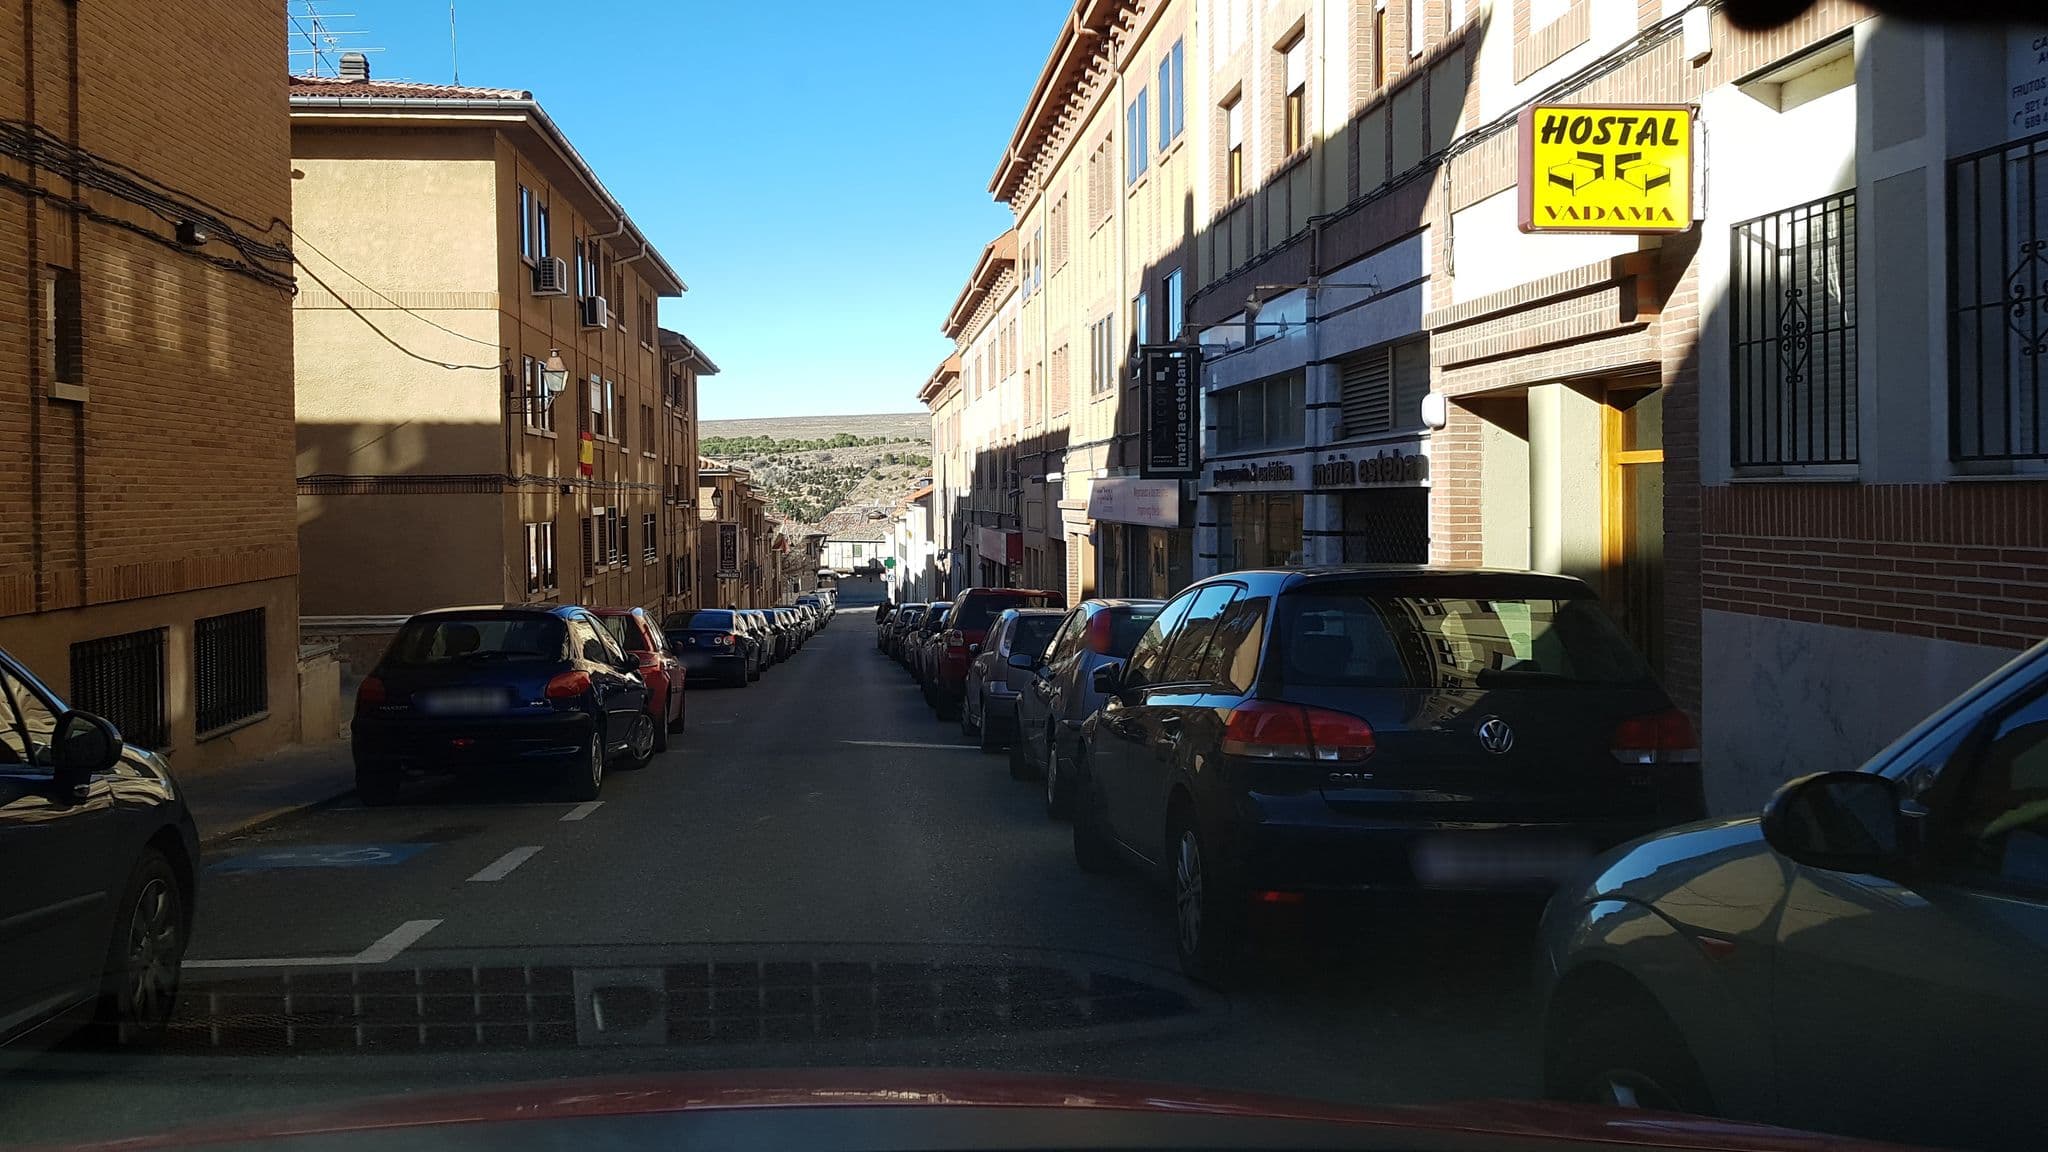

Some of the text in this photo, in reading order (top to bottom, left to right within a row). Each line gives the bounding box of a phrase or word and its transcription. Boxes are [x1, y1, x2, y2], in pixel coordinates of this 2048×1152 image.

[1541, 115, 1680, 147] HOSTAL
[1544, 205, 1675, 222] VADAMA
[1174, 358, 1188, 421] esteban
[1358, 449, 1430, 482] esteban
